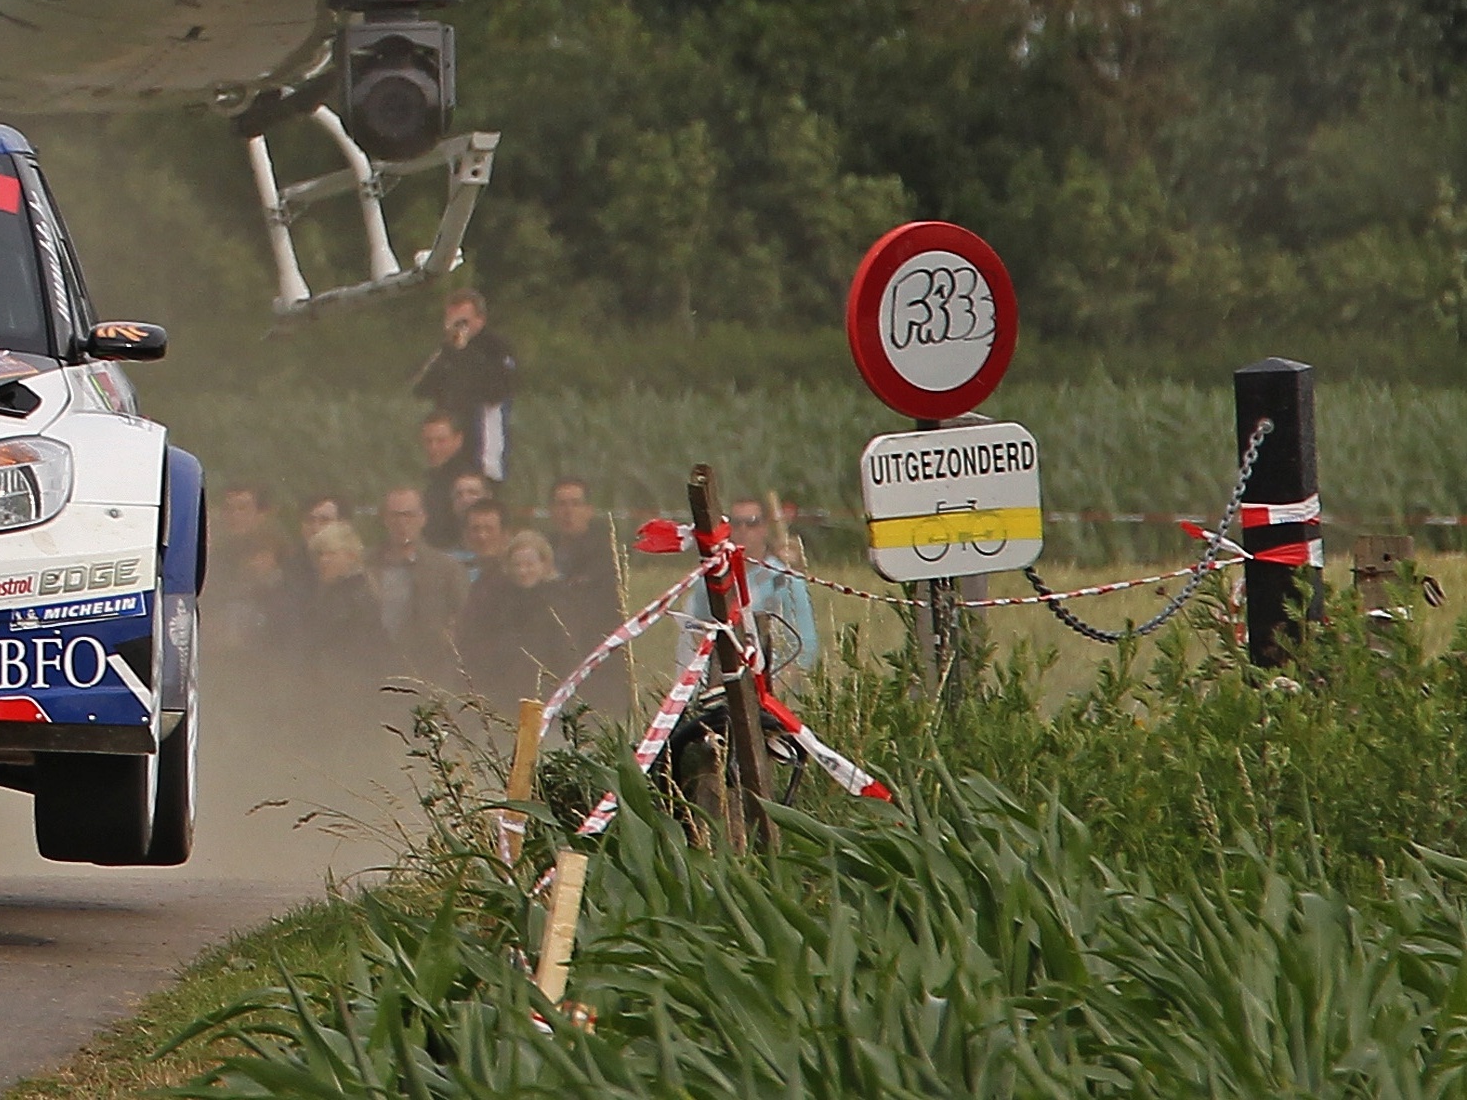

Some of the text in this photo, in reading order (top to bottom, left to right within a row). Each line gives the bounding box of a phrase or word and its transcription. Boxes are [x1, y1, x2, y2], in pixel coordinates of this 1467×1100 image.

[870, 441, 1034, 486] UITGEZONDERD
[38, 557, 140, 596] EDGE
[43, 597, 137, 620] MICHELIN
